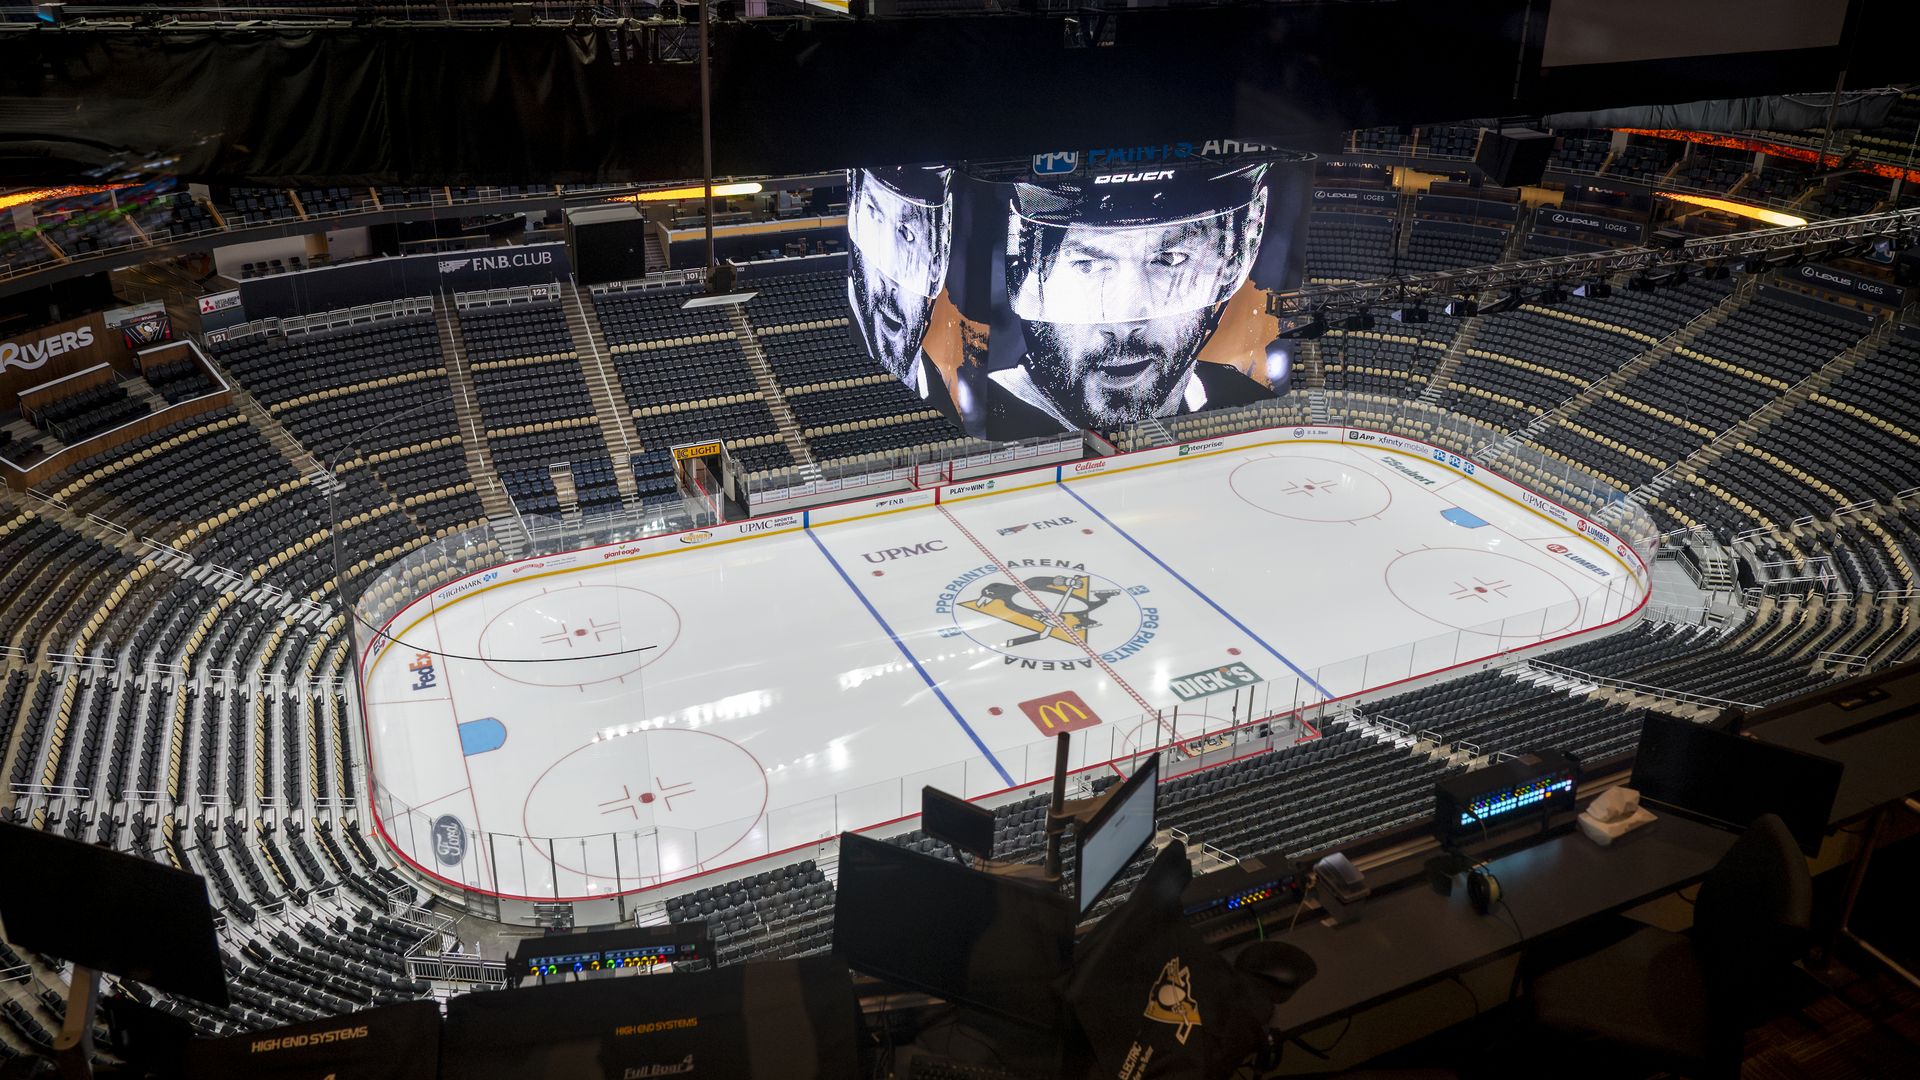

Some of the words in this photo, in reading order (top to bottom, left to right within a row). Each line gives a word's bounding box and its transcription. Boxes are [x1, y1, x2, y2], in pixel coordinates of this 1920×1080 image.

[1363, 194, 1385, 202] LOGES
[1565, 217, 1600, 227] LEXUS
[1604, 223, 1627, 233] LOGES
[472, 255, 511, 271] F.N.B.
[512, 251, 553, 267] CLUB
[686, 272, 698, 280] 101
[1815, 271, 1852, 286] LEXUS
[1857, 281, 1883, 295] LOGES
[532, 288, 547, 296] 122
[211, 333, 227, 342] 121
[677, 447, 689, 459] IC
[690, 445, 717, 456] LIGHT
[1378, 436, 1404, 448] xfinity
[1404, 442, 1429, 454] mobile
[1075, 461, 1106, 472] Caliente
[950, 487, 965, 495] PLAY
[971, 484, 985, 492] WIN!
[1522, 492, 1549, 512] UPMC
[739, 520, 773, 533] UPMC
[774, 519, 798, 528] MEDICINE
[1587, 526, 1610, 544] LUMBER
[603, 550, 622, 559] giant
[622, 547, 640, 556] eagle
[861, 540, 948, 563] UPMC
[1007, 558, 1085, 572] ARENA
[1564, 552, 1611, 577] LUMBER
[936, 592, 953, 614] PPG
[950, 564, 998, 593] PAINTS
[1142, 607, 1160, 629] PPG
[1101, 628, 1156, 664] PAINTS
[409, 652, 436, 691] FedEx
[1004, 655, 1092, 671] ARENA
[1171, 666, 1252, 698] DICK'S
[437, 822, 460, 856] Ford
[251, 1039, 280, 1053] HIGH
[282, 1035, 308, 1048] END
[309, 1026, 368, 1045] SYSTEMS
[624, 1065, 649, 1080] Full
